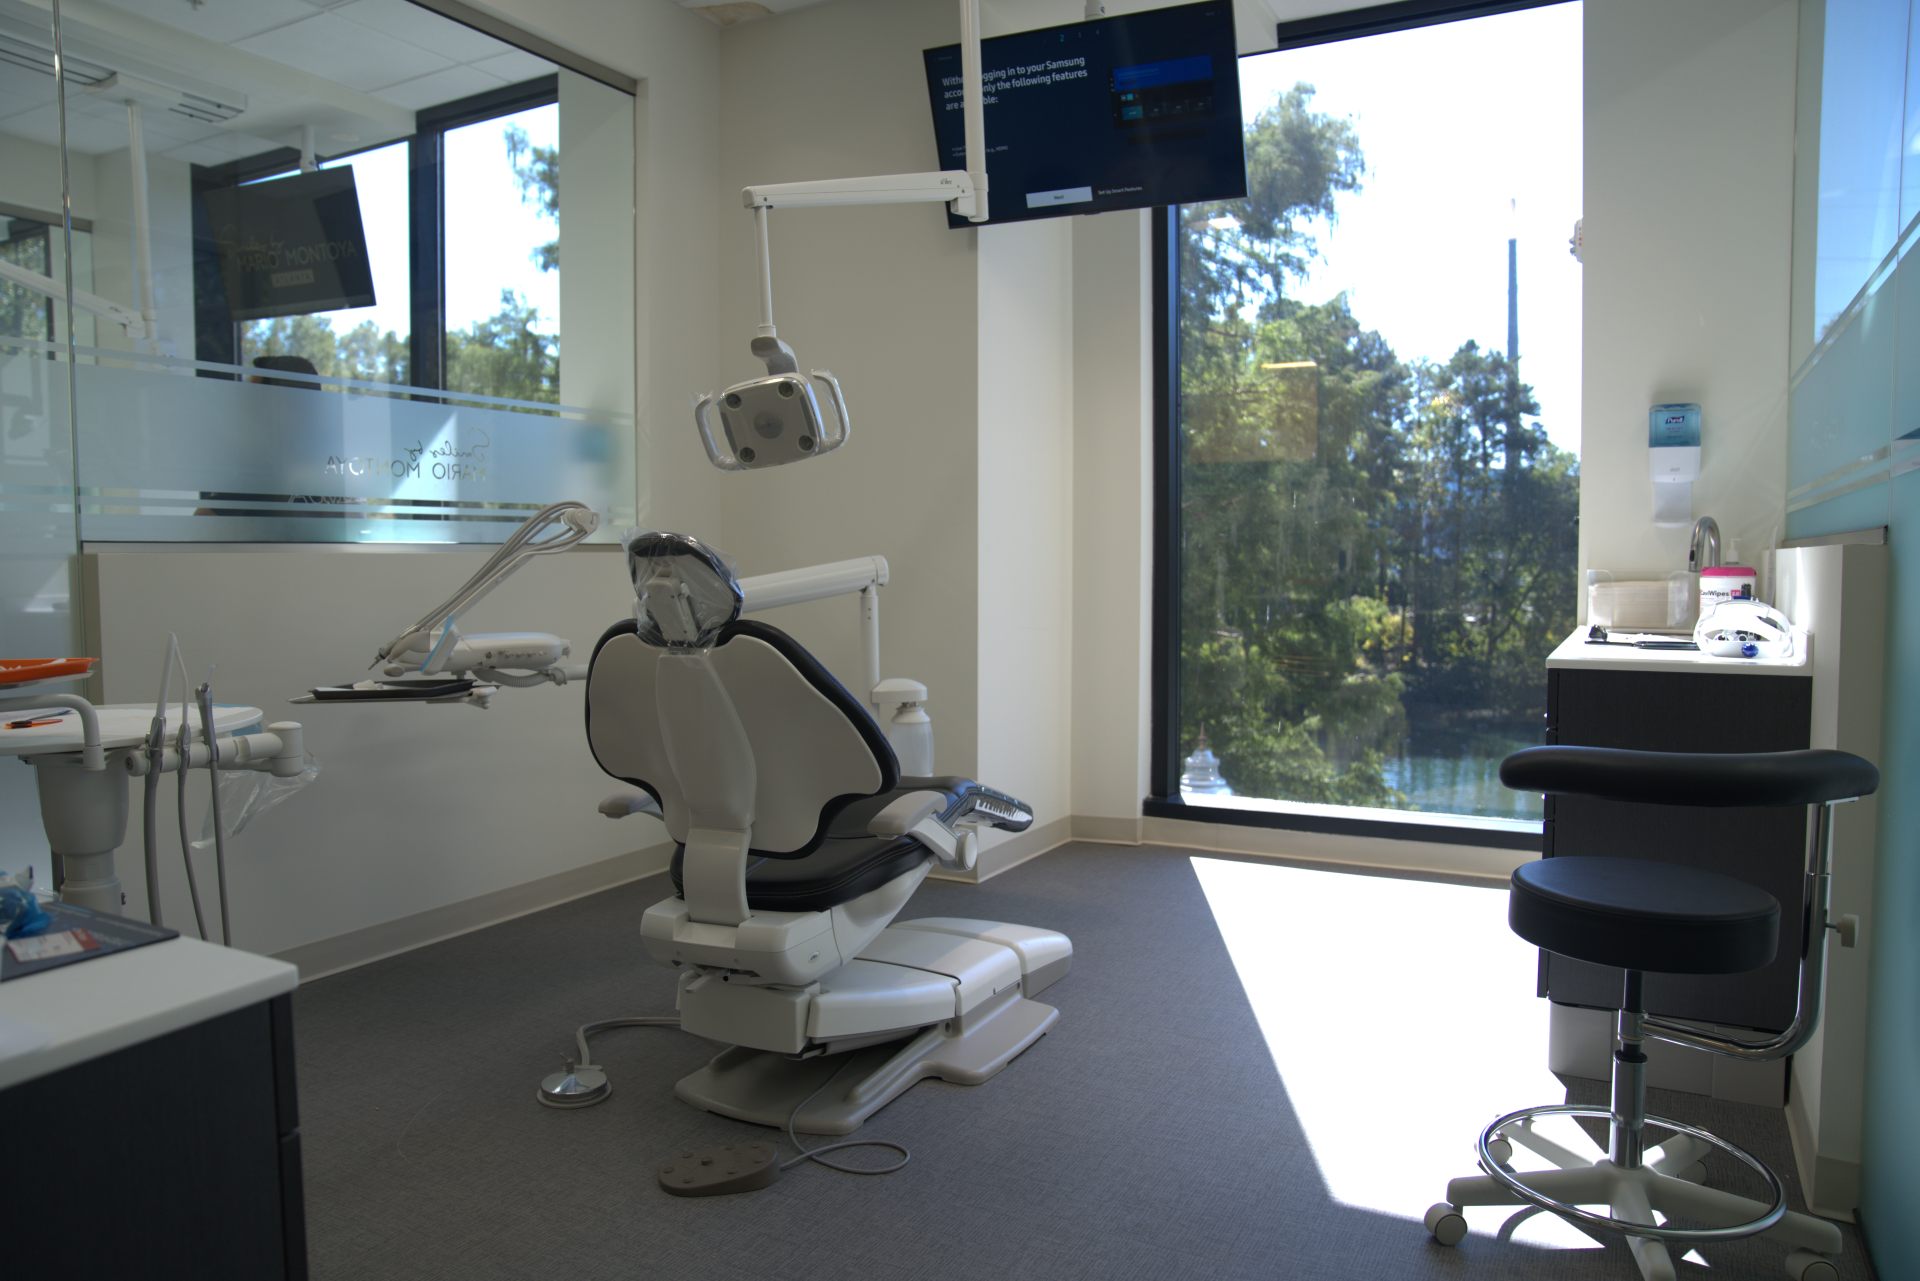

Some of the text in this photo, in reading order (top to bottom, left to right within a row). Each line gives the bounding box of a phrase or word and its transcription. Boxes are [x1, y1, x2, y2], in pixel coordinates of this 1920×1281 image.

[942, 57, 1085, 87] With gging in to your Samsung
[944, 69, 1088, 99] acco nly the following features
[945, 102, 959, 111] are
[284, 240, 358, 266] MONTOYA
